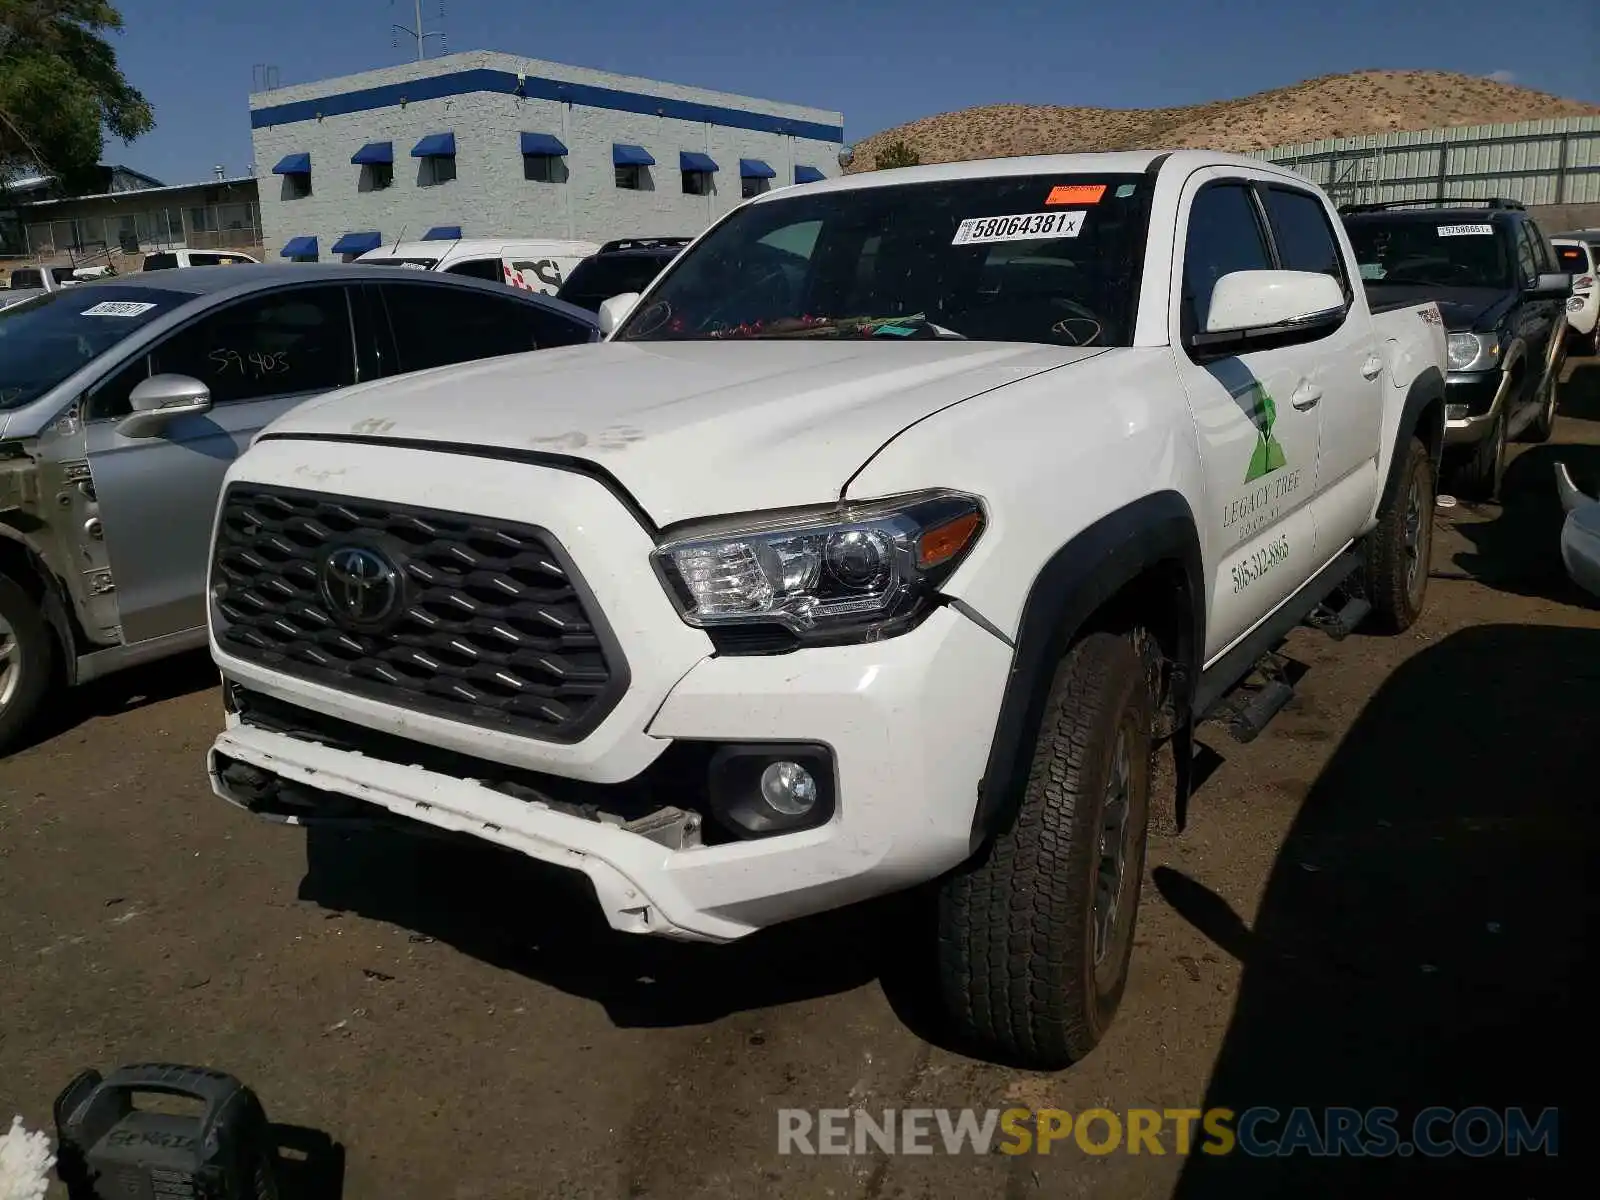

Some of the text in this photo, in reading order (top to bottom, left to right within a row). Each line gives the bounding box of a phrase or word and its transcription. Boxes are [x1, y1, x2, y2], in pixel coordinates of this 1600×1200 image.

[973, 214, 1066, 237] 58064381
[1223, 484, 1271, 528] LEGACY
[1275, 469, 1300, 499] TREE
